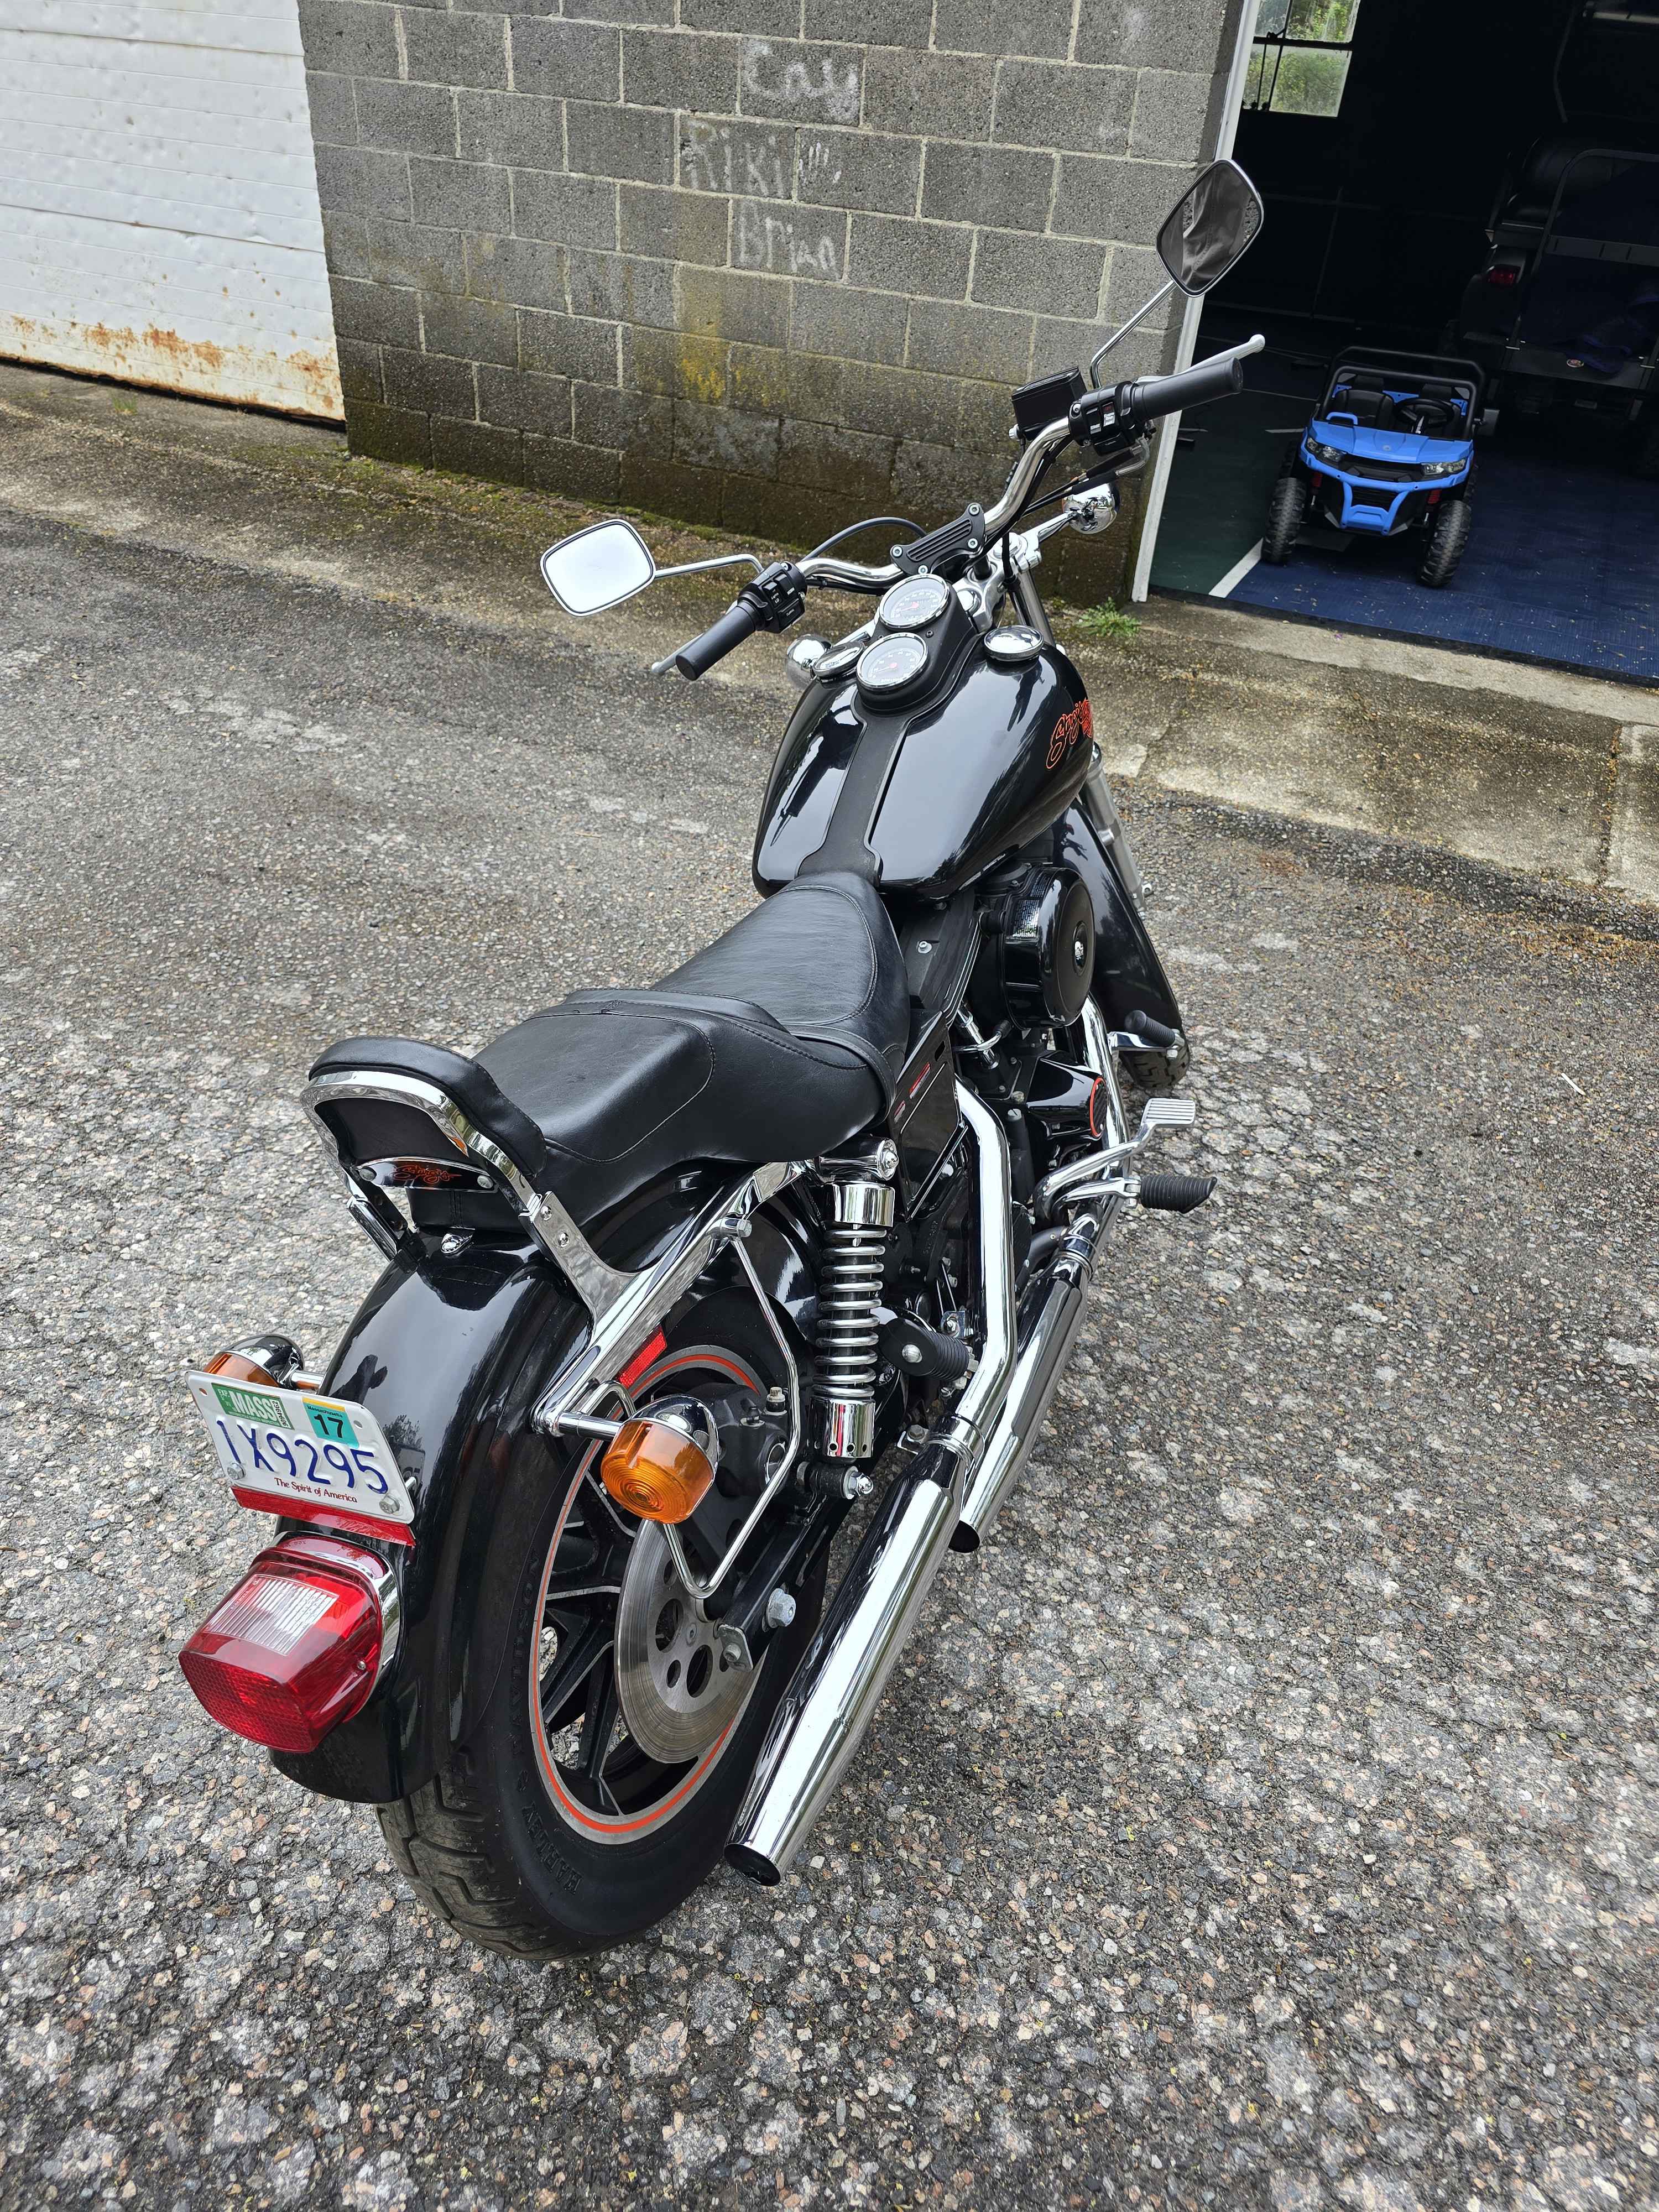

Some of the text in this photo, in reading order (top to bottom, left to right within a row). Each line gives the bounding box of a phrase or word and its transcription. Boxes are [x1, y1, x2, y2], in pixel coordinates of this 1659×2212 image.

[388, 1164, 462, 1185] Sturgis
[229, 1390, 277, 1421] MASS
[314, 1414, 343, 1438] 17
[216, 1420, 389, 1494] 1X9295
[274, 1478, 358, 1503] The Spirit of America
